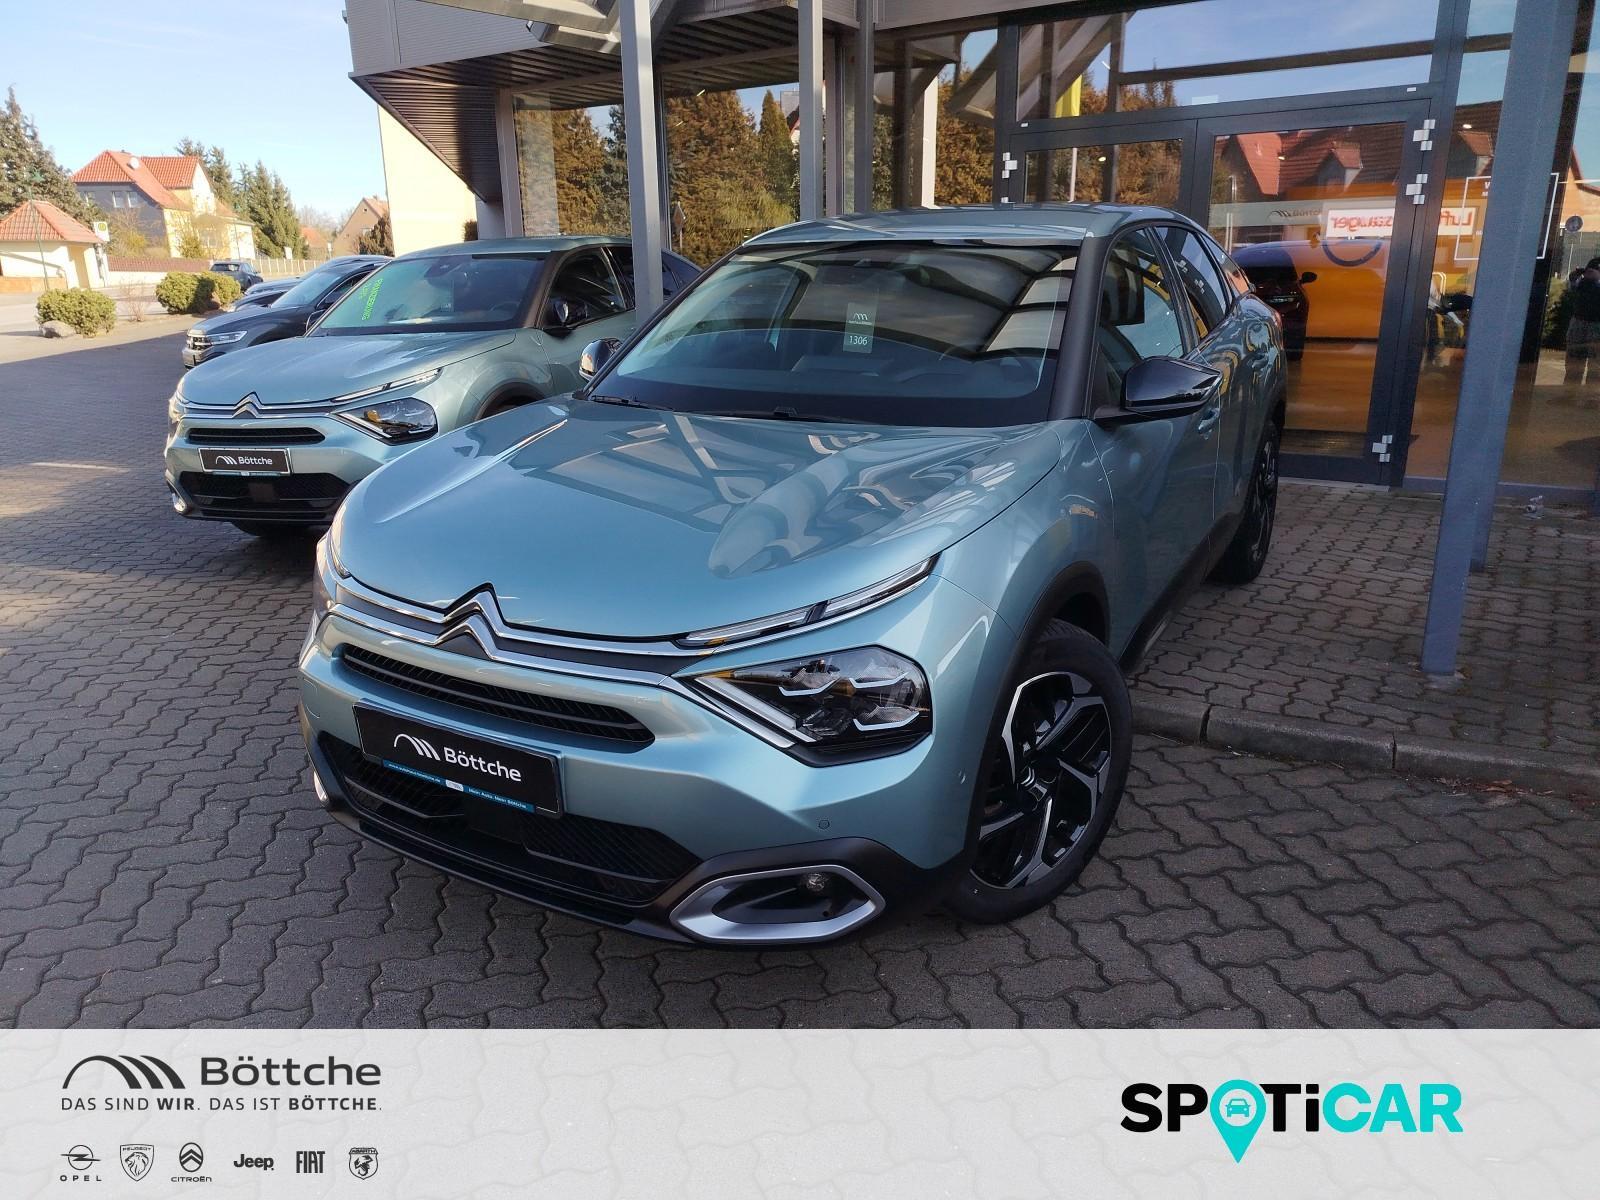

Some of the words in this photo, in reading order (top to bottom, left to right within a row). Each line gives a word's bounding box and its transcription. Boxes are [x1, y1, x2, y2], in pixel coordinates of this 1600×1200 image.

[849, 335, 868, 346] 1306
[238, 456, 273, 465] Böttche
[443, 746, 522, 782] Böttche
